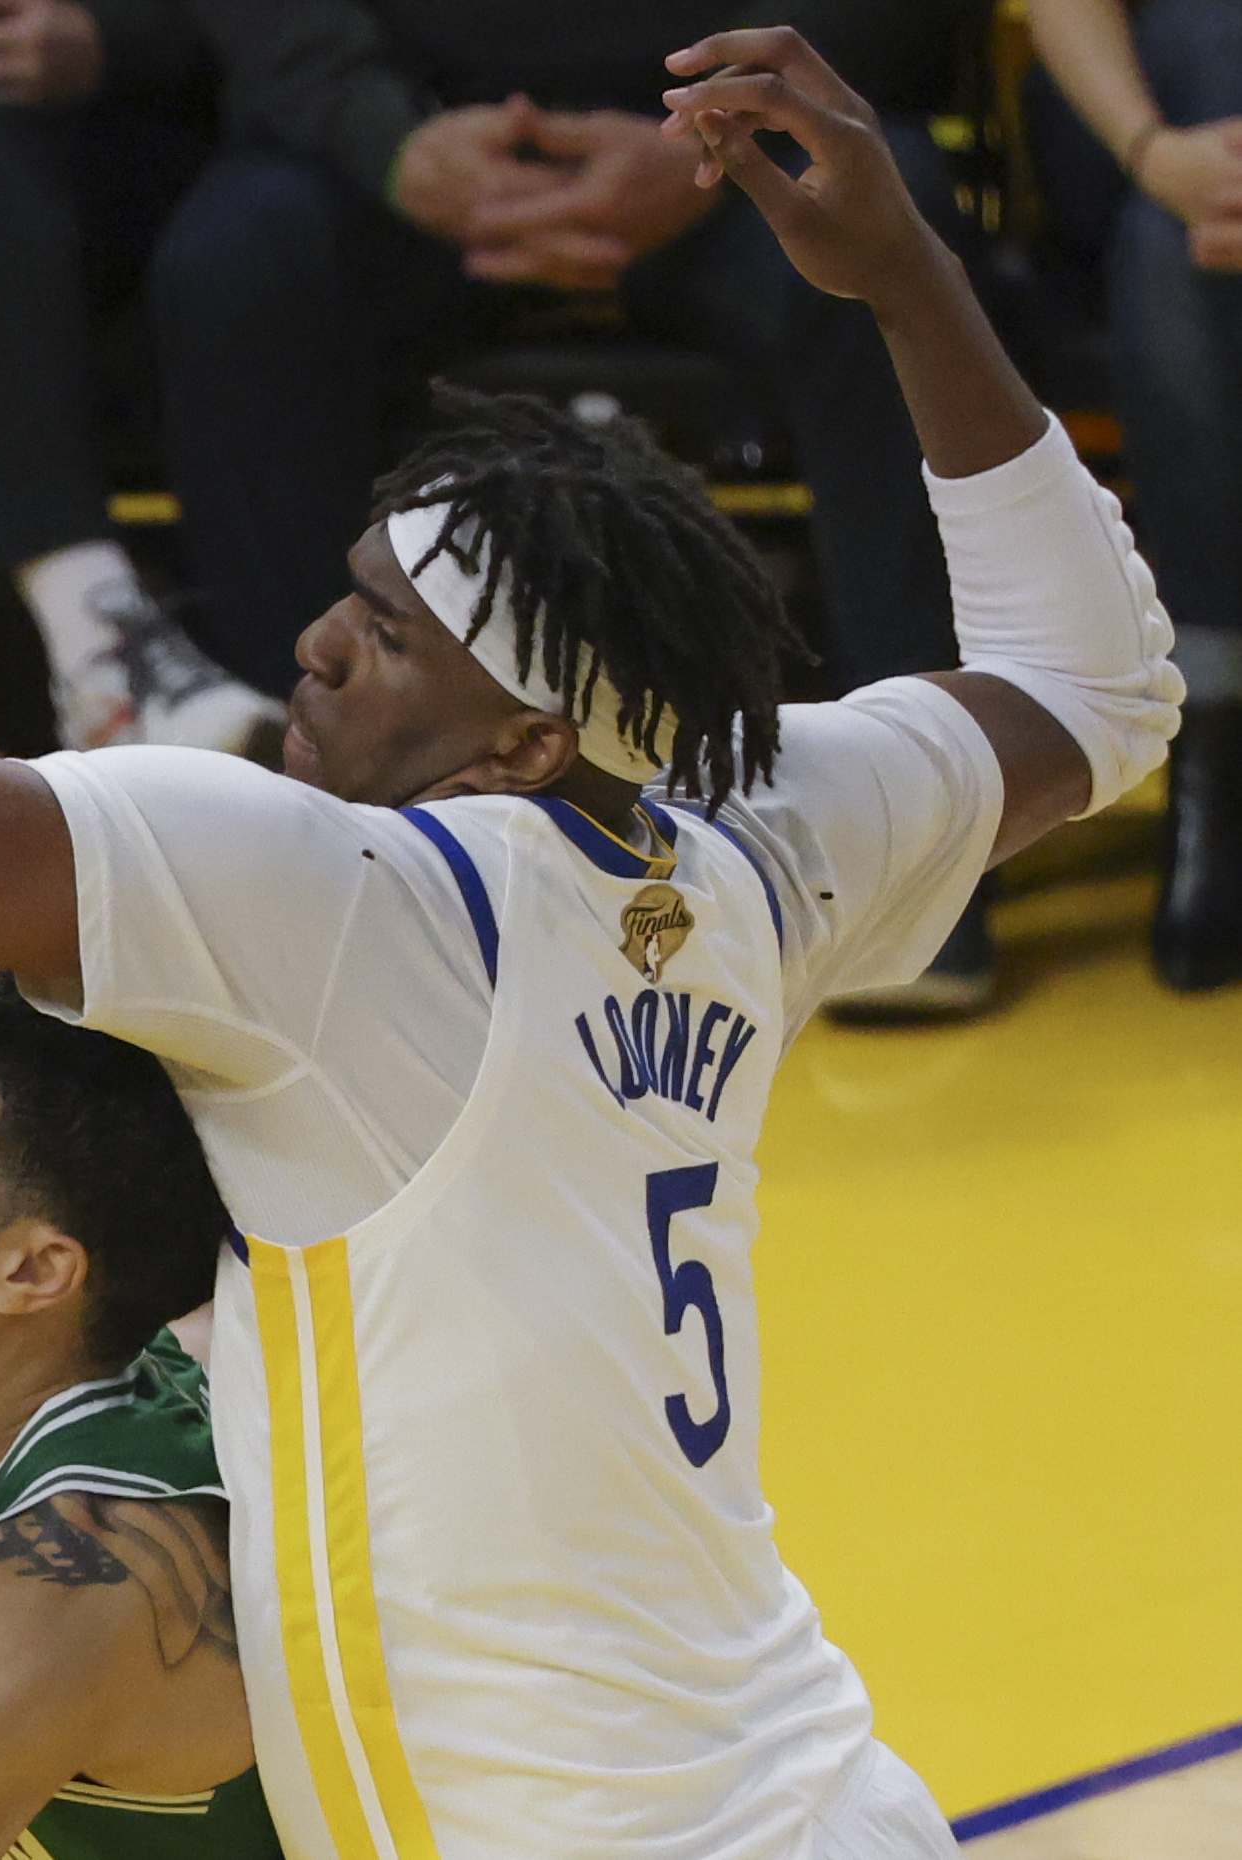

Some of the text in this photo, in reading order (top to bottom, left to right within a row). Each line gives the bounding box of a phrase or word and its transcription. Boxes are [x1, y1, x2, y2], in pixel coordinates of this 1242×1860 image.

[620, 899, 692, 951] Finals
[575, 989, 757, 1123] LOONEY
[646, 1161, 730, 1468] 5
